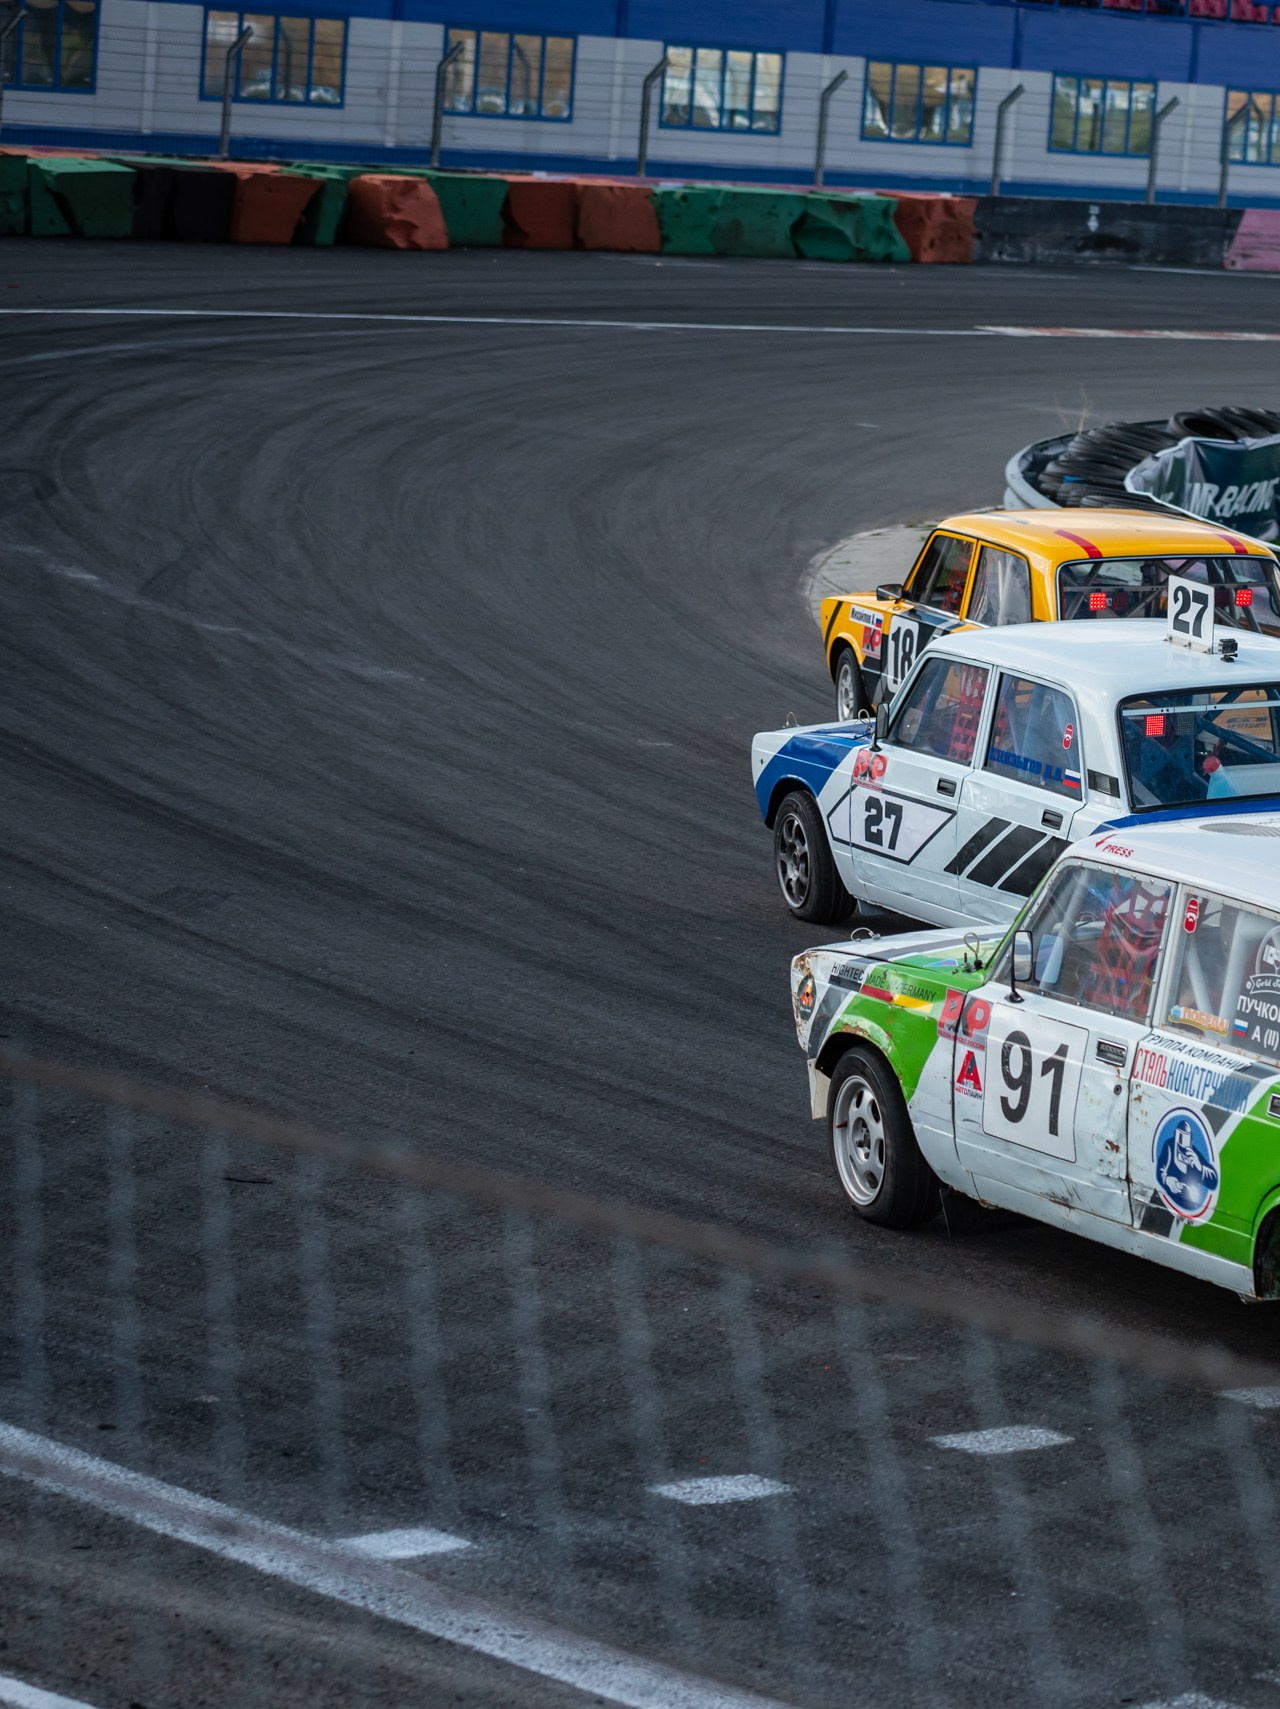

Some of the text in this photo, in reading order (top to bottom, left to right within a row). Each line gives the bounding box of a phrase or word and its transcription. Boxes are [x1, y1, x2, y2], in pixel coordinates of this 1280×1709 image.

[1173, 585, 1209, 639] 27
[891, 626, 915, 685] 18
[864, 795, 904, 851] 27
[1102, 844, 1134, 857] PRESS
[831, 962, 865, 982] HIGHTEC
[865, 973, 886, 989] MADE
[1147, 1033, 1187, 1052] ГРУППА
[1000, 1030, 1069, 1137] 91
